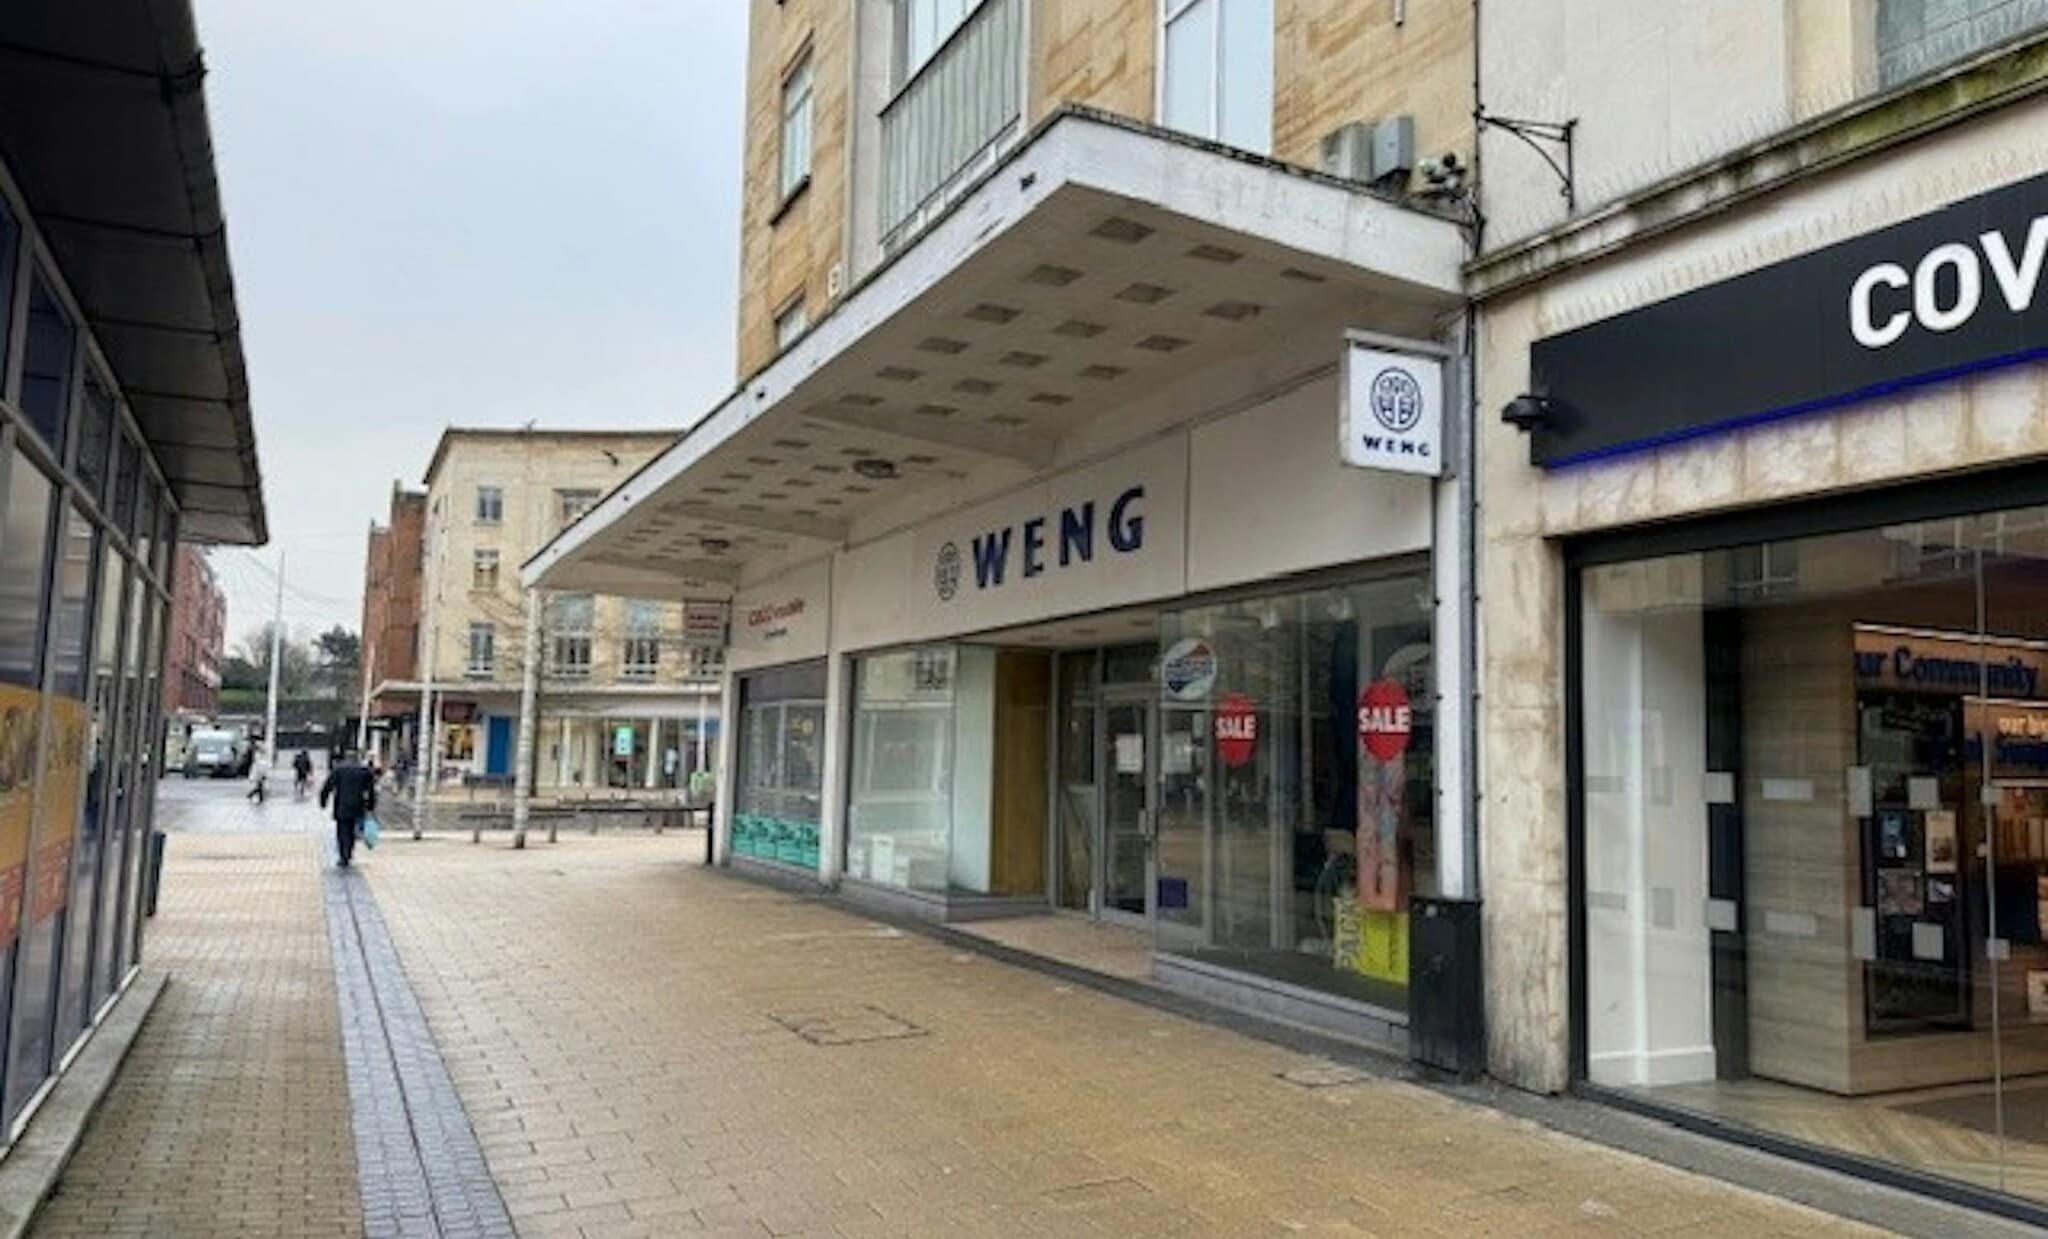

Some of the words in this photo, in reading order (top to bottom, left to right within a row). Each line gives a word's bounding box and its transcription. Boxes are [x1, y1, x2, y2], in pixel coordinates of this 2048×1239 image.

[1851, 215, 2048, 347] COV
[1363, 435, 1431, 457] WENG
[973, 485, 1144, 589] WENG
[1215, 714, 1257, 740] SALE
[1358, 705, 1410, 733] SALE
